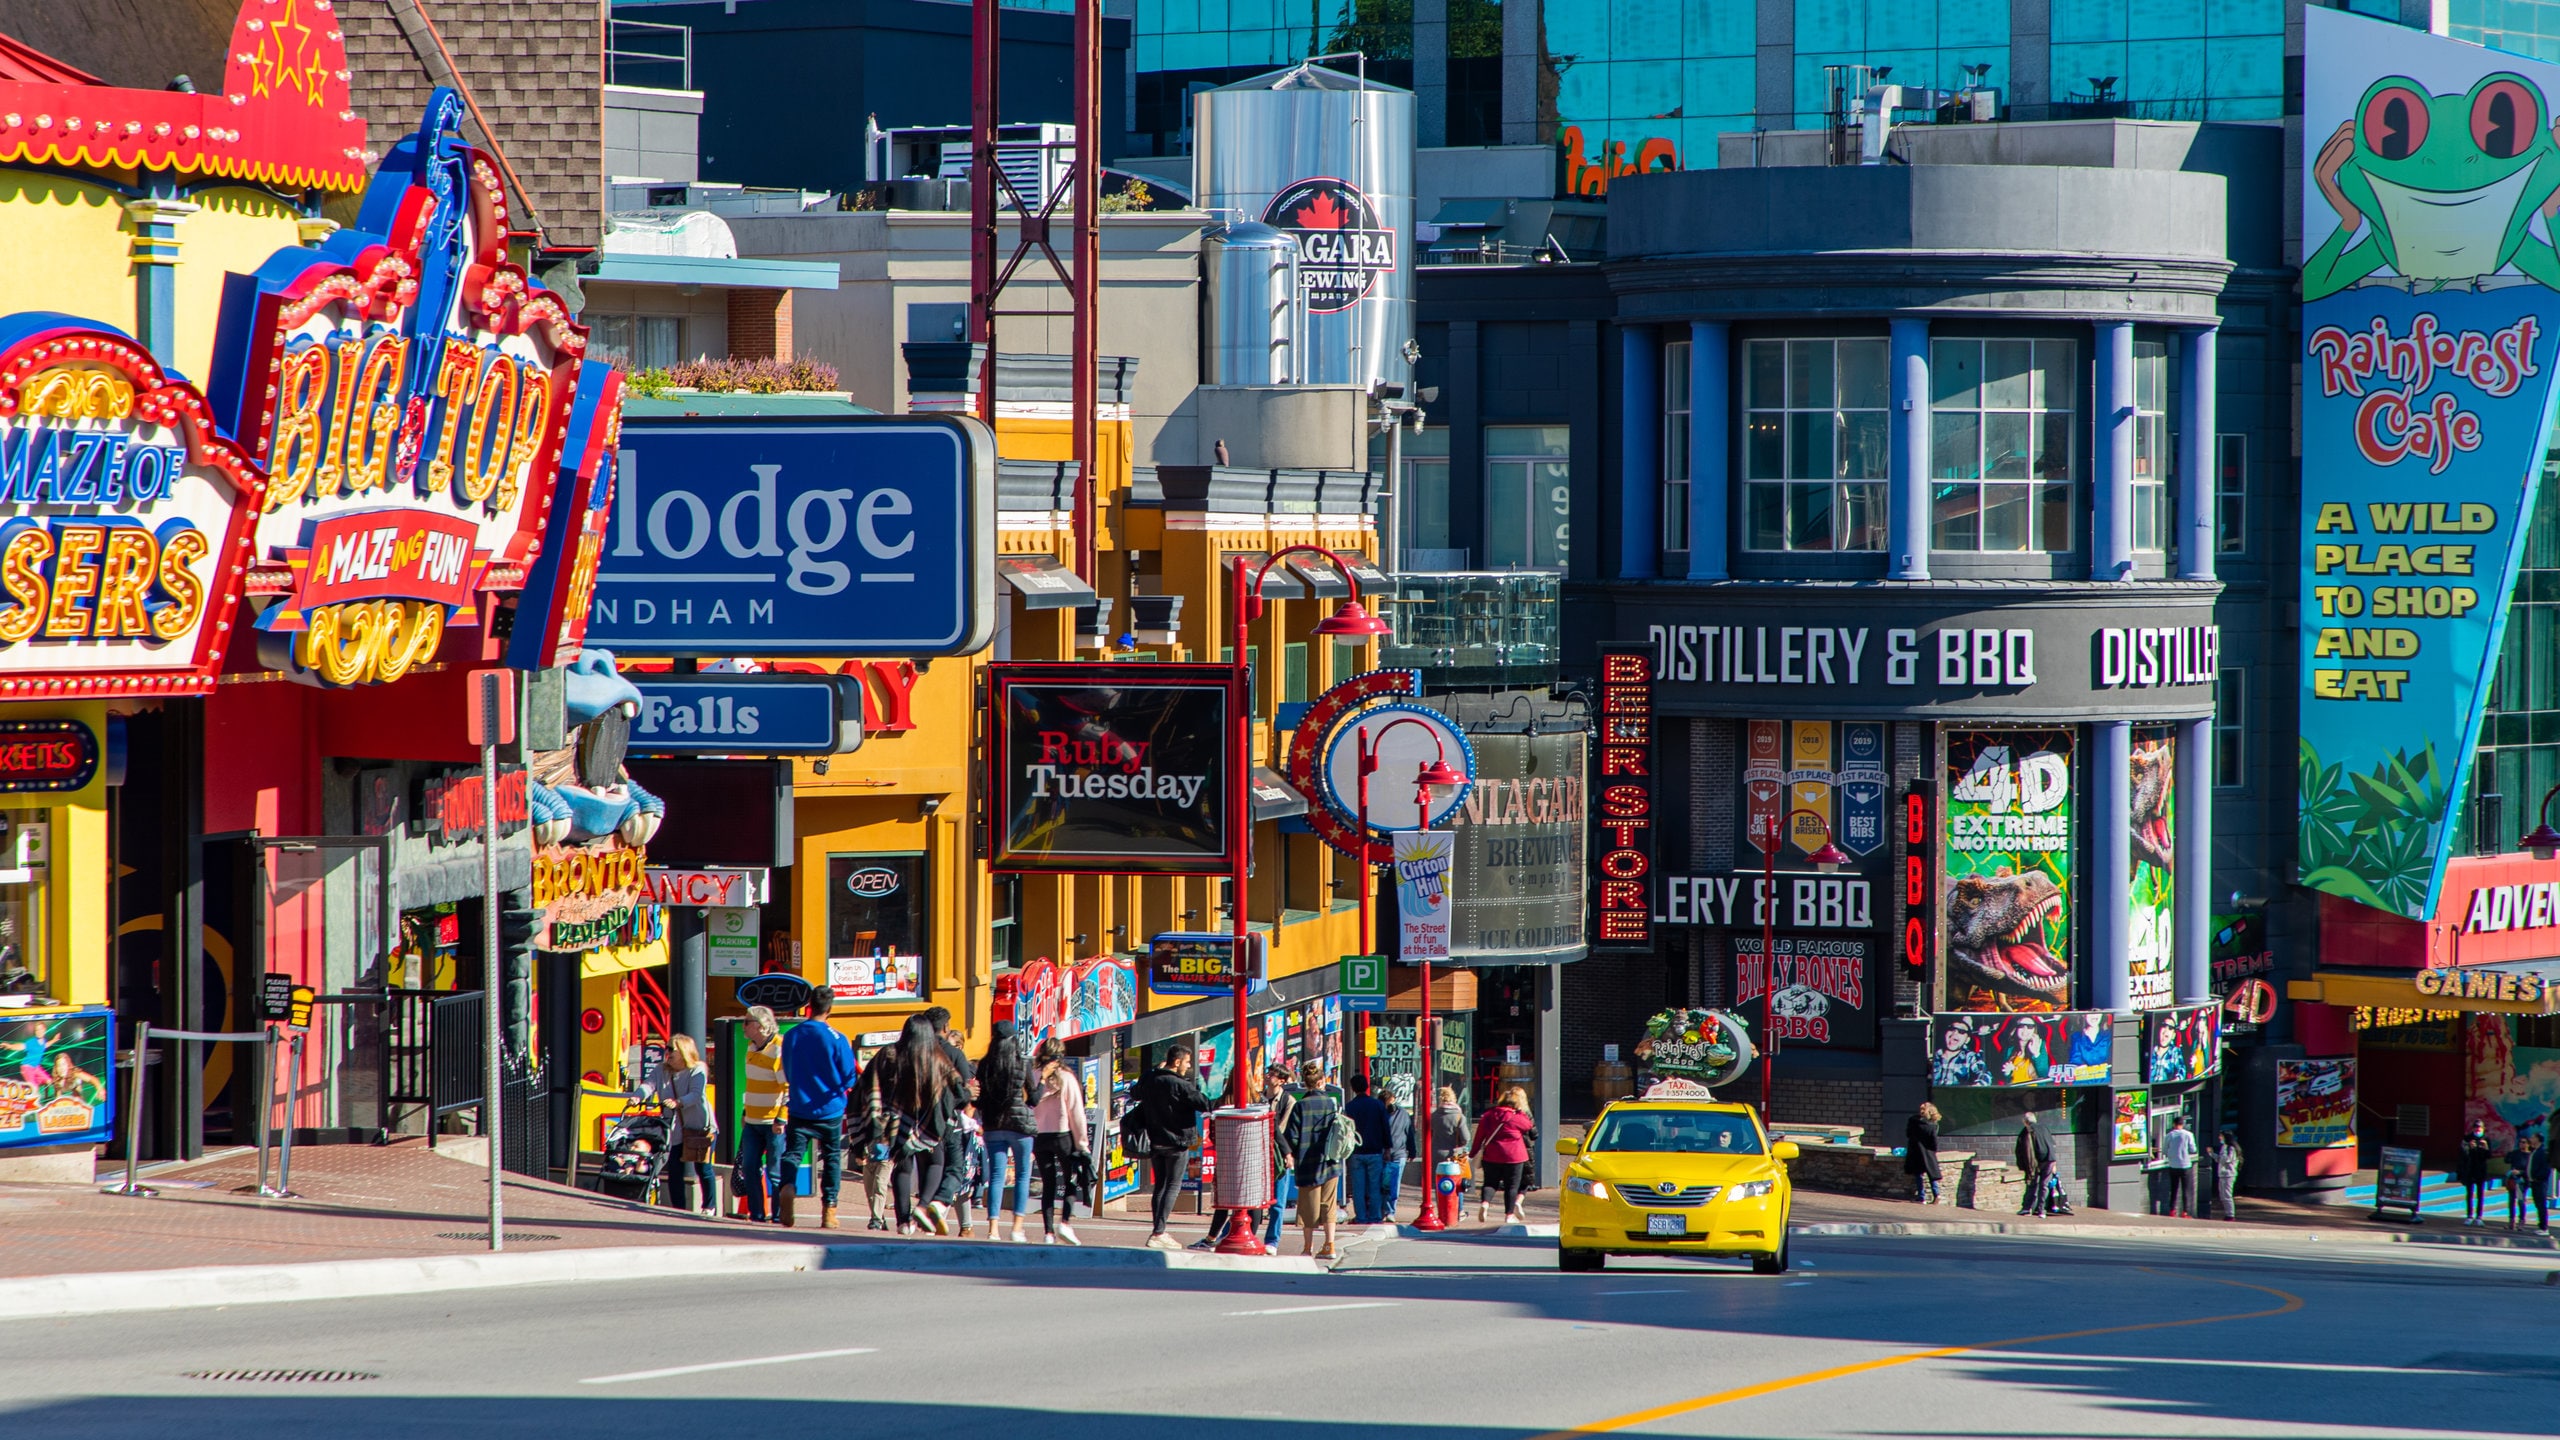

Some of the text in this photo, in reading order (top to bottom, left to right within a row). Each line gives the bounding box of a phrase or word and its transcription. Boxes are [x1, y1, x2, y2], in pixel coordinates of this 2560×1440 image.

[2309, 313, 2539, 398] Rainforest
[264, 333, 553, 513] BIG TOP
[2354, 384, 2483, 475] Cafe
[130, 446, 187, 502] OF
[2315, 502, 2496, 533] A WILD
[417, 530, 469, 586] FUN!
[2315, 544, 2475, 575] PLACE
[2315, 586, 2478, 617] TO SHOP
[1649, 624, 1869, 684] DISTILLERY
[1887, 628, 1919, 685] &
[1938, 628, 2037, 685] BBQ
[2314, 628, 2419, 658] AND
[2314, 669, 2409, 700] EAT
[637, 695, 760, 734] Falls
[1037, 731, 1151, 772] Ruby
[1756, 735, 1772, 743] 2019
[1853, 737, 1872, 745] 2019
[1025, 764, 1206, 808] Tuesday
[1746, 769, 1783, 779] 1ST PLACE
[1791, 770, 1832, 780] 1ST PLACE
[1841, 771, 1886, 781] 1ST PLACE
[1953, 746, 2069, 815] 4D
[1600, 655, 1651, 940] BEER STORE
[1750, 825, 1778, 836] SAUE
[1795, 826, 1827, 836] BRISKET
[1798, 816, 1823, 827] BEST
[1849, 816, 1876, 828] BEST
[1850, 827, 1875, 838] RIBS
[1953, 816, 2068, 835] EXTREME
[1486, 834, 1579, 868] BREWING
[1953, 836, 2068, 851] MOTION RIDE
[1400, 856, 1448, 881] Clifton
[1905, 793, 1926, 967] BBQ
[850, 873, 898, 890] OPEN
[1415, 874, 1444, 898] Hill
[1753, 879, 1779, 926] &
[1793, 879, 1873, 928] BBQ
[556, 906, 629, 945] PLAYLAND
[1404, 922, 1446, 933] The Street
[716, 937, 752, 946] PARKING
[1403, 944, 1447, 954] at the Falls
[1413, 933, 1437, 944] of fun
[1479, 929, 1511, 950] ICE
[1514, 927, 1552, 949] COLD
[1735, 938, 1864, 956] WOLD FAMOUS
[2128, 905, 2172, 974] 4D
[1162, 964, 1180, 973] The
[1171, 974, 1206, 982] VALUE
[1180, 958, 1222, 975] BIG
[1354, 963, 1372, 990] P
[2211, 952, 2274, 981] TREME
[742, 984, 807, 1001] OPEN
[1795, 954, 1863, 1010] BONES
[2415, 969, 2542, 1002] GAMES
[2225, 978, 2277, 1024] 4D
[1377, 1026, 1416, 1040] RAF
[1770, 1014, 1830, 1043] BBQ
[1652, 1039, 1709, 1061] Rainforest
[1668, 1081, 1687, 1089] TAXI
